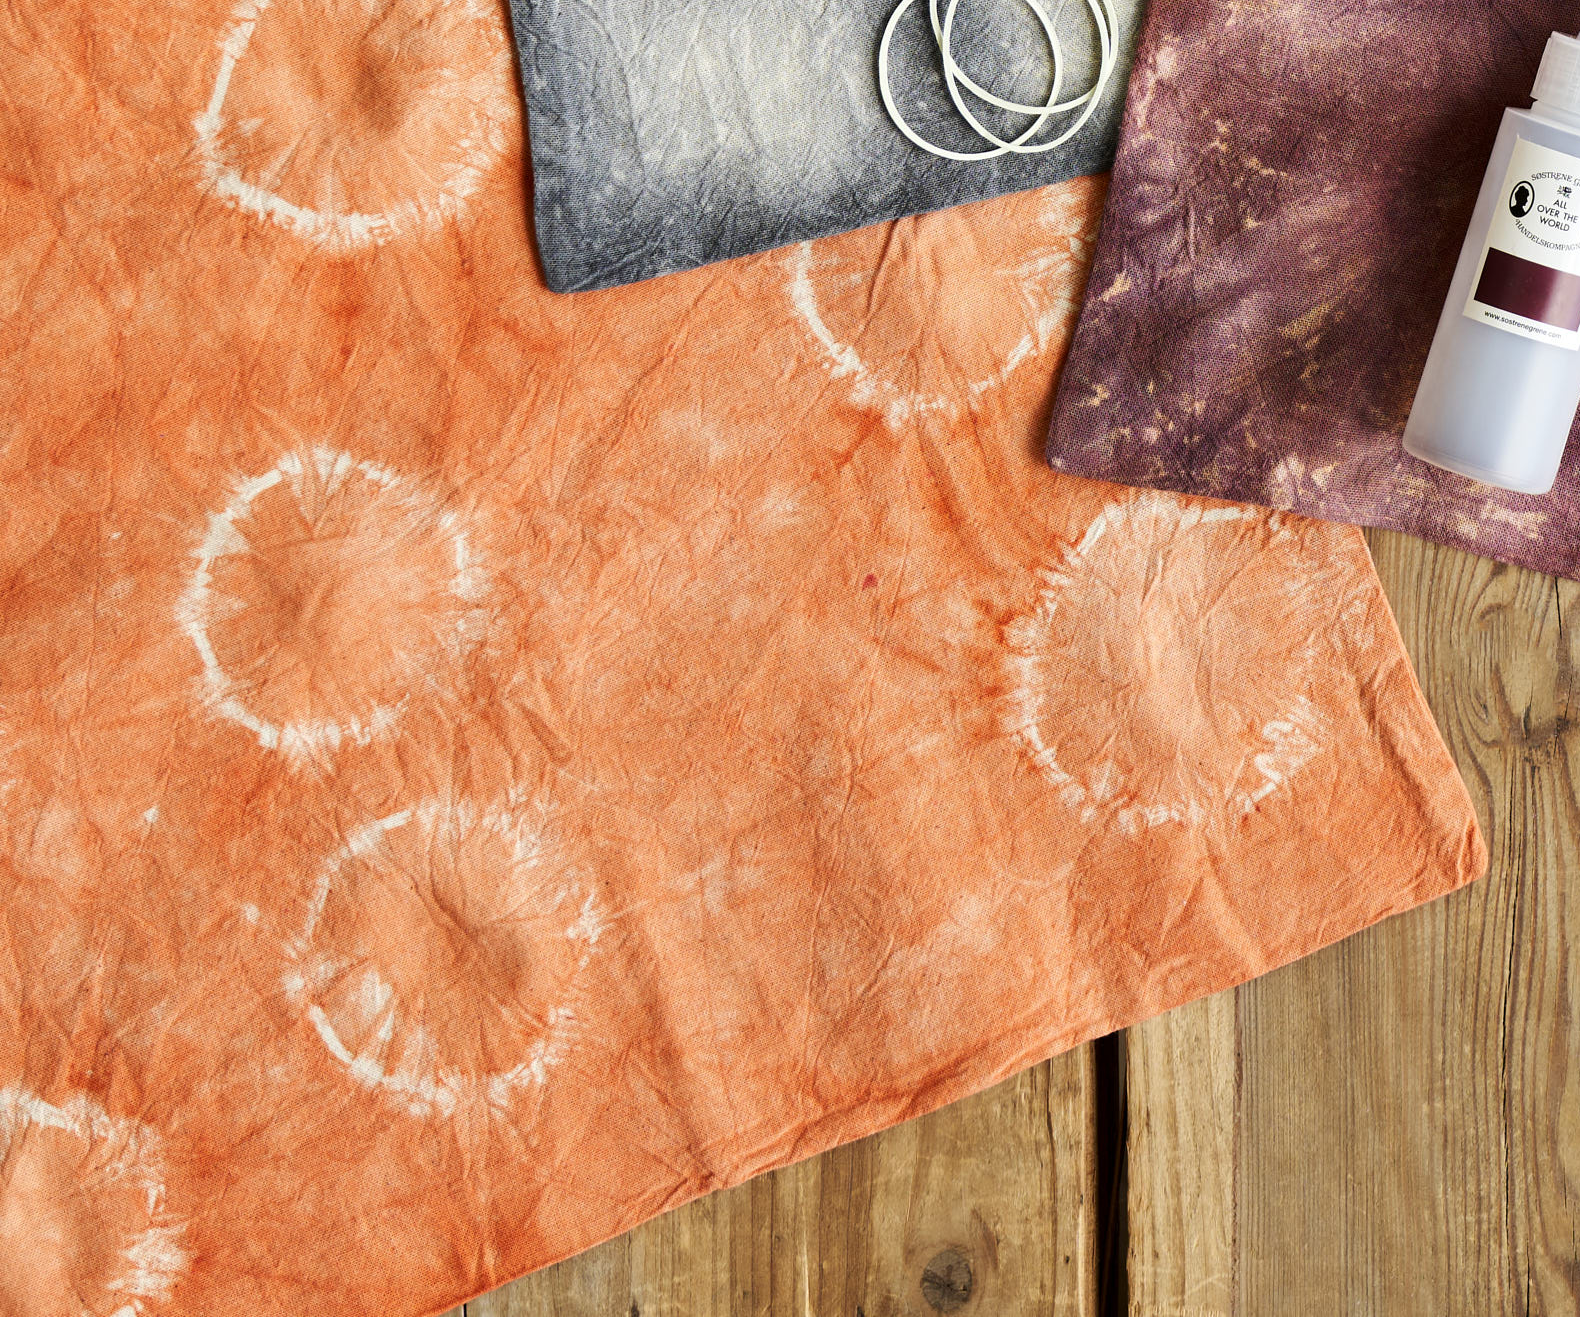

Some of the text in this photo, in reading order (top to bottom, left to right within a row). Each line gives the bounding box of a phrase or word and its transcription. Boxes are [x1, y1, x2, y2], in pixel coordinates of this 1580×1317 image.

[1531, 172, 1572, 182] SØSTRENE
[1553, 199, 1567, 209] ALL
[1537, 205, 1579, 223] OVER THE
[1539, 216, 1570, 232] WORLD
[1484, 311, 1561, 339] www.sostrenegrene.com
